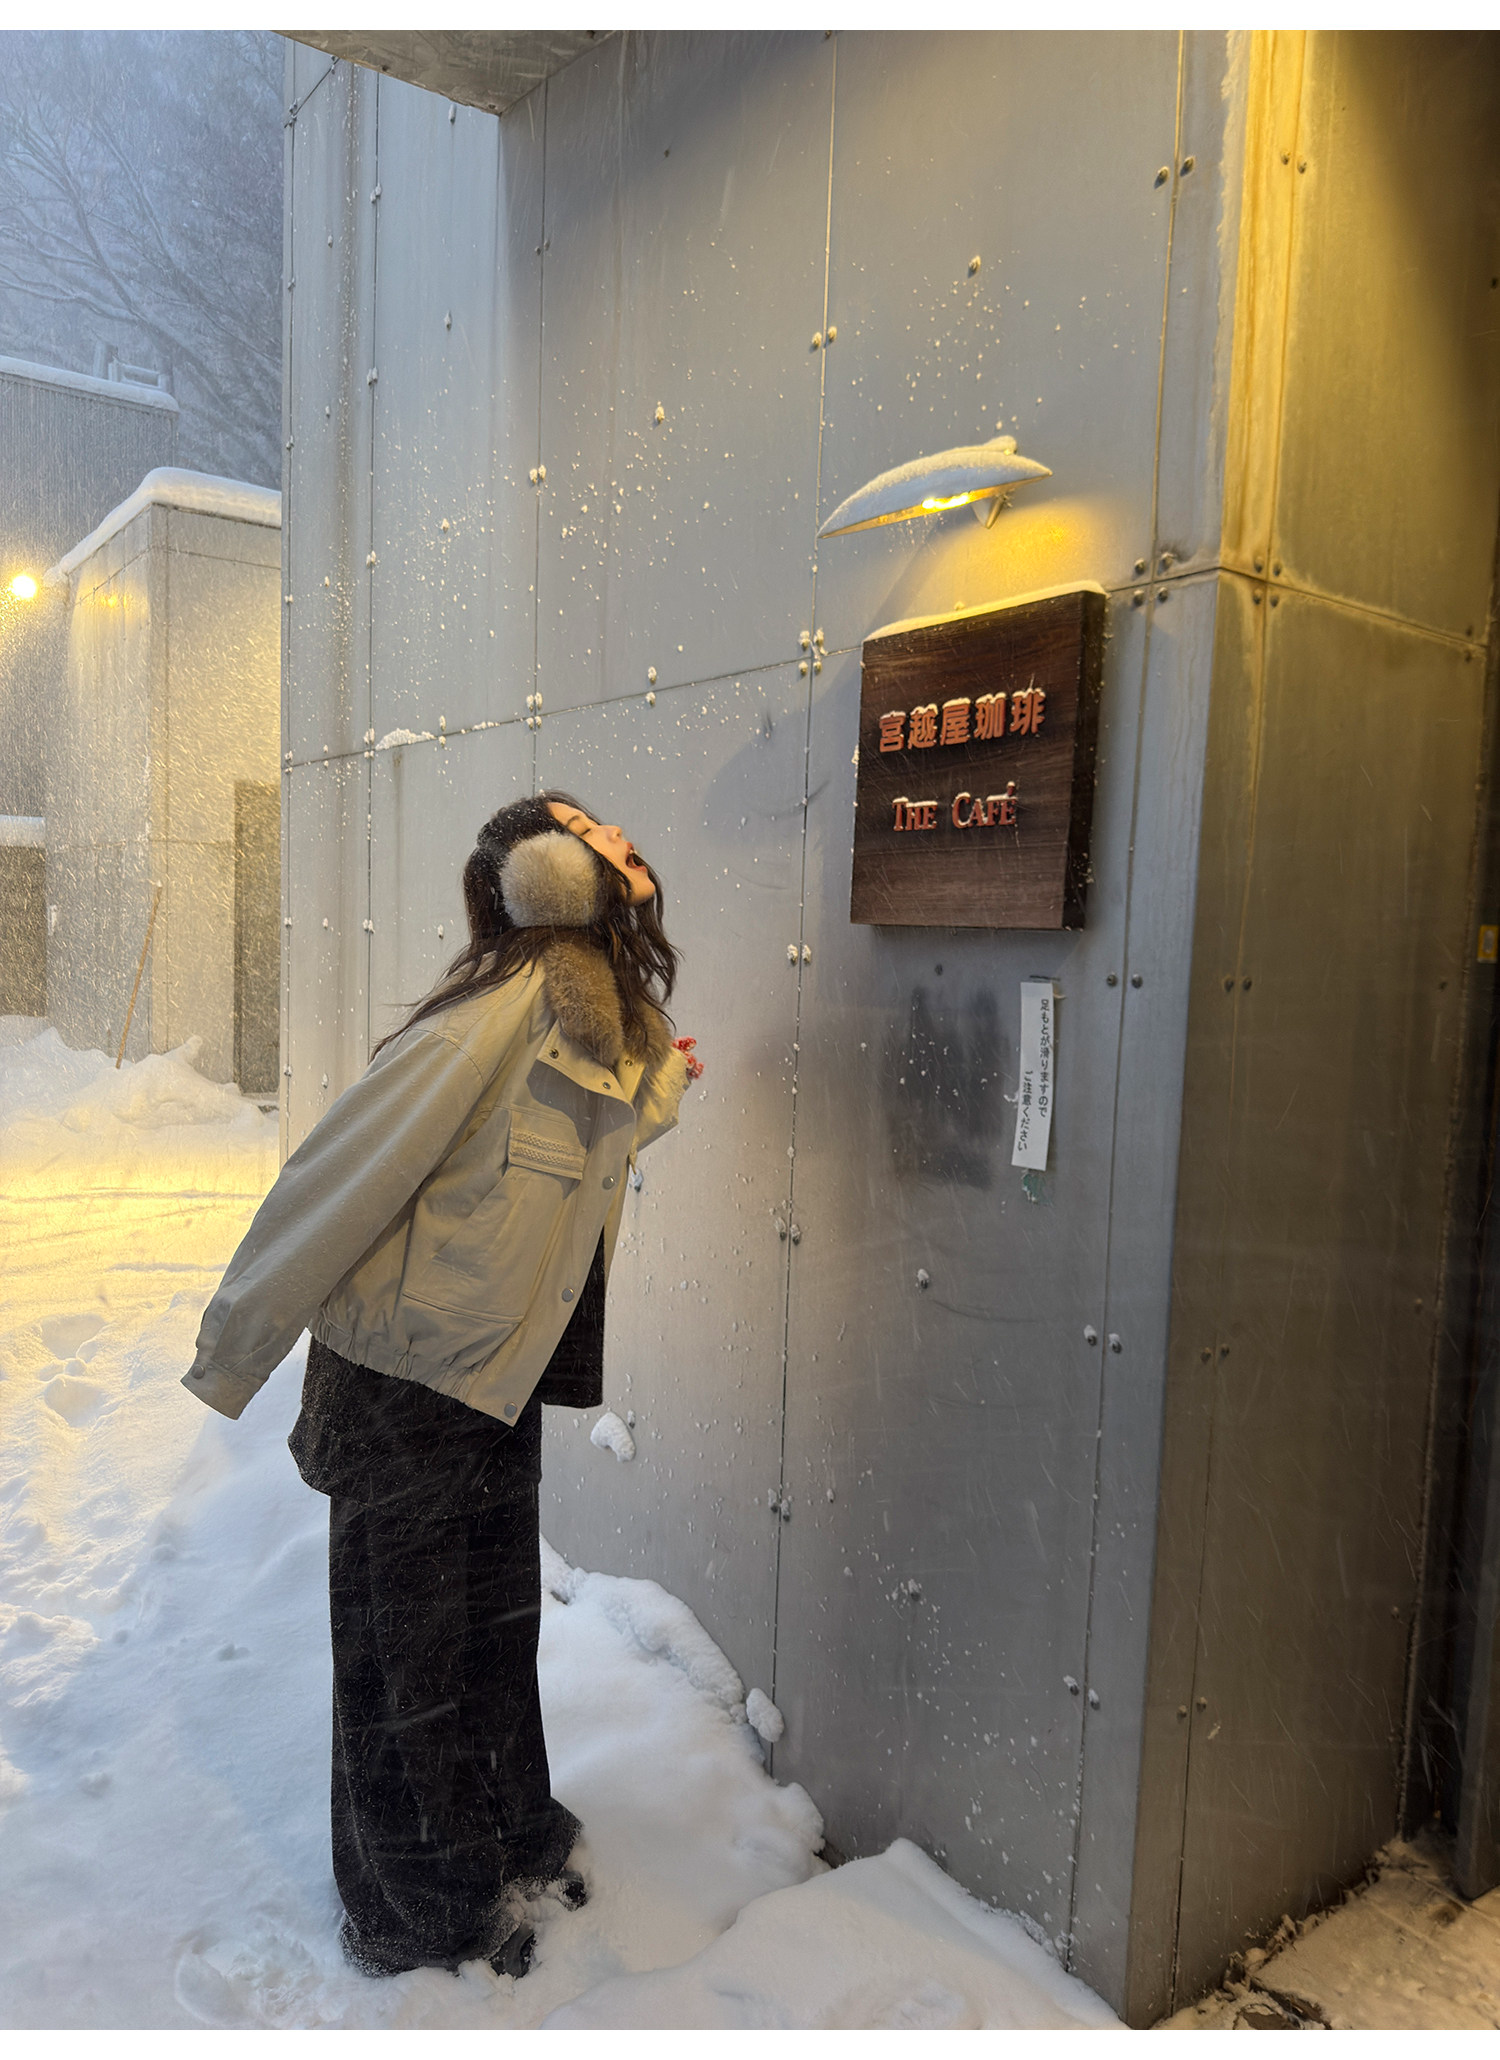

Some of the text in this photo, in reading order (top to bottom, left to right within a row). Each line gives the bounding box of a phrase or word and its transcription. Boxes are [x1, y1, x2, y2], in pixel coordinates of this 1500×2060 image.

[879, 688, 1046, 753] 宮越屋珈琲
[892, 782, 1018, 831] THE CAFÉ
[1038, 998, 1051, 1118] 足もとが滑りますので
[1017, 1069, 1034, 1152] ご注意ください
